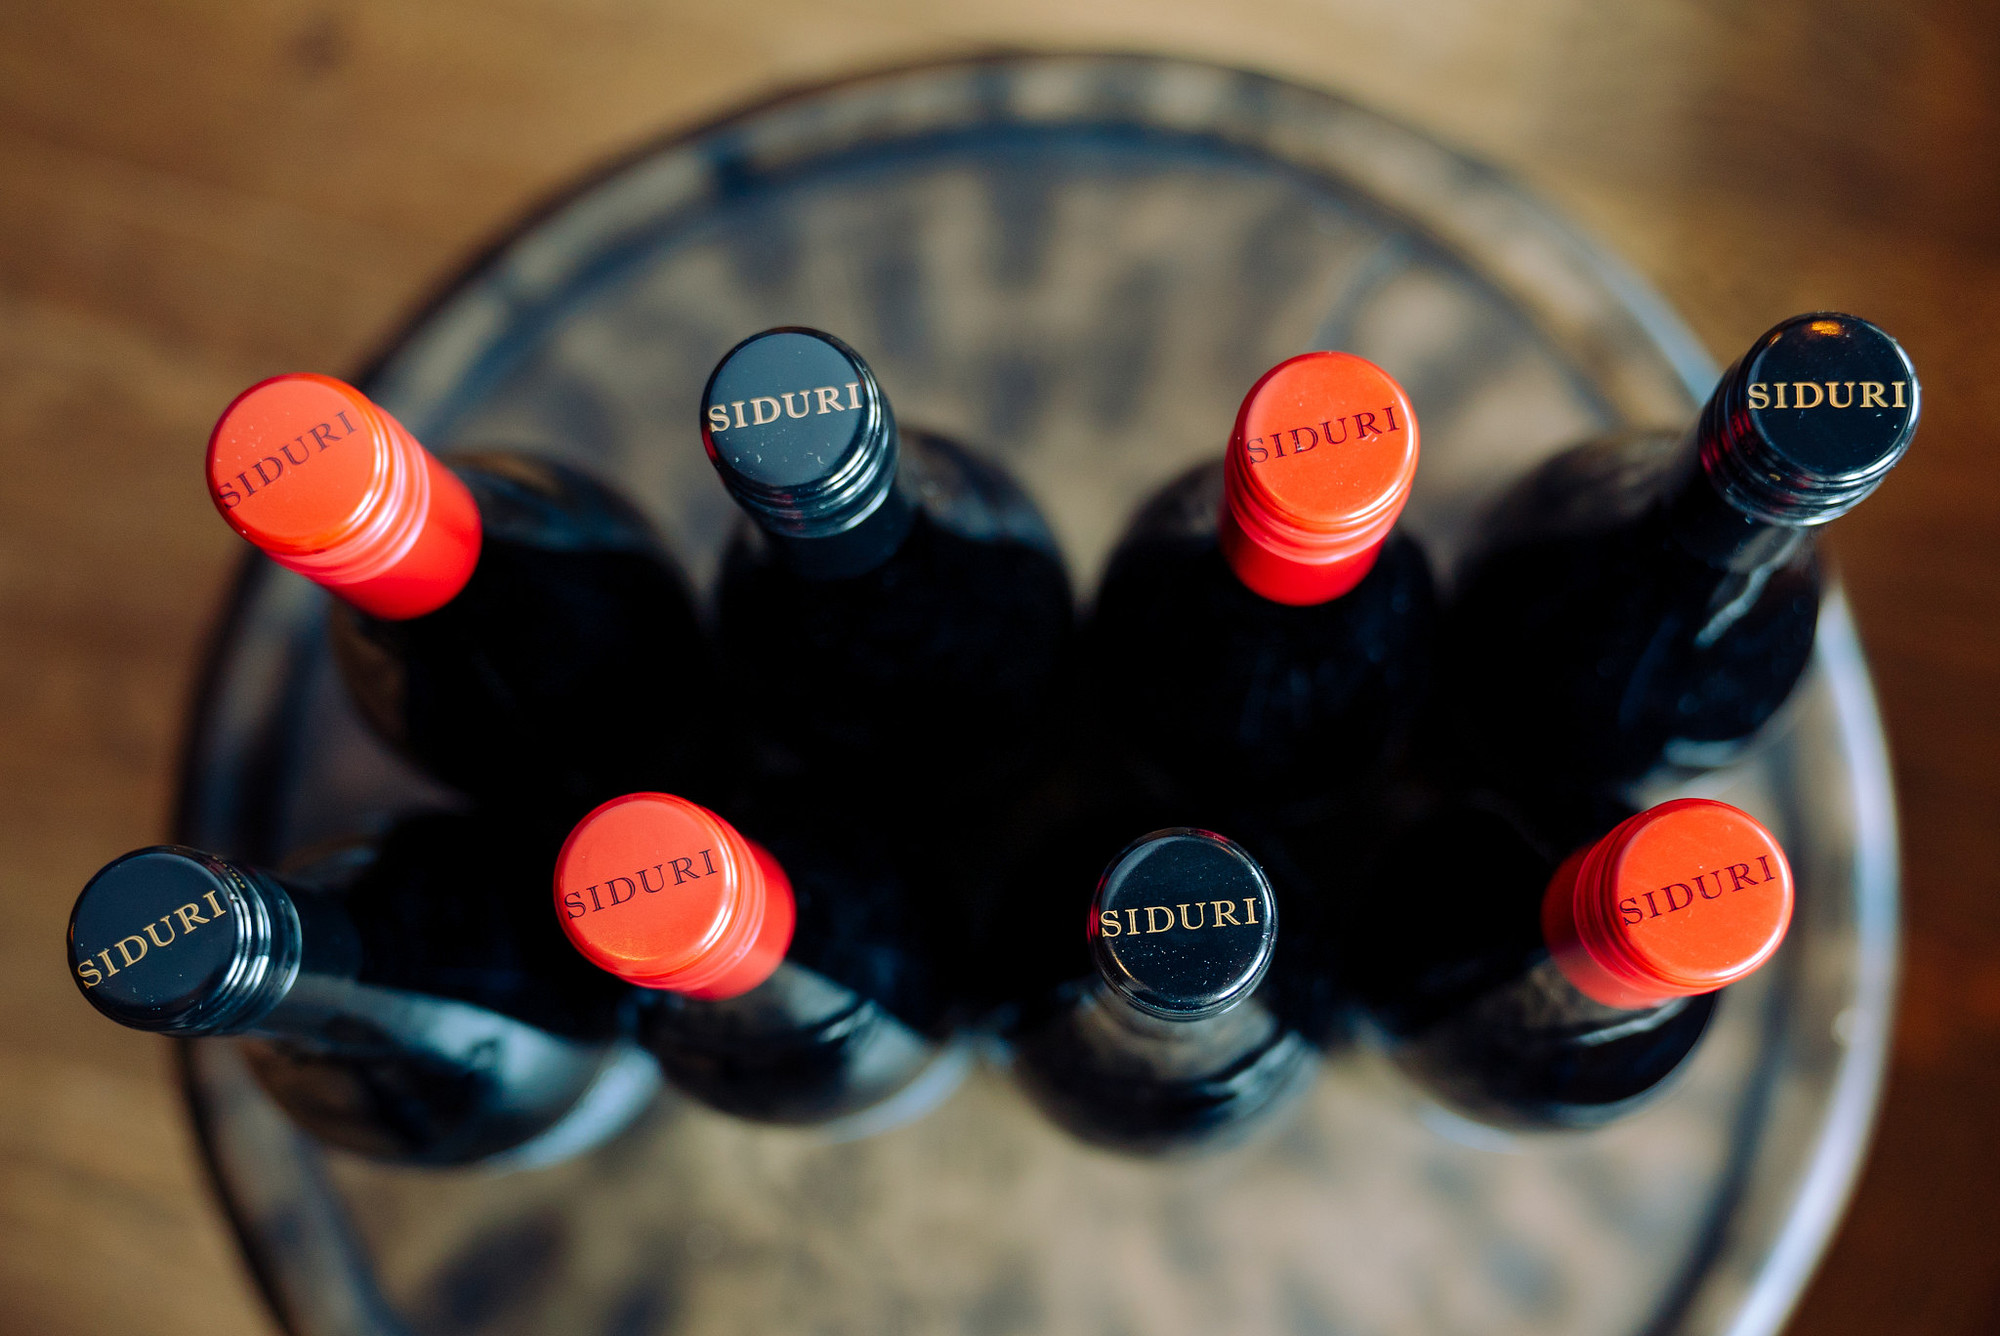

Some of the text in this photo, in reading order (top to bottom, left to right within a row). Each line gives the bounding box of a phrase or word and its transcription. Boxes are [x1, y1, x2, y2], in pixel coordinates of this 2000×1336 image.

[707, 381, 864, 432] SIDURI
[1747, 381, 1907, 410] SIDURI
[219, 410, 358, 509] SIDURI
[1247, 406, 1400, 464] SIDURI
[564, 849, 717, 919] SIDURI
[1618, 855, 1776, 926] SIDURI
[77, 890, 226, 988] SIDURI
[1100, 897, 1259, 937] SIDURI
